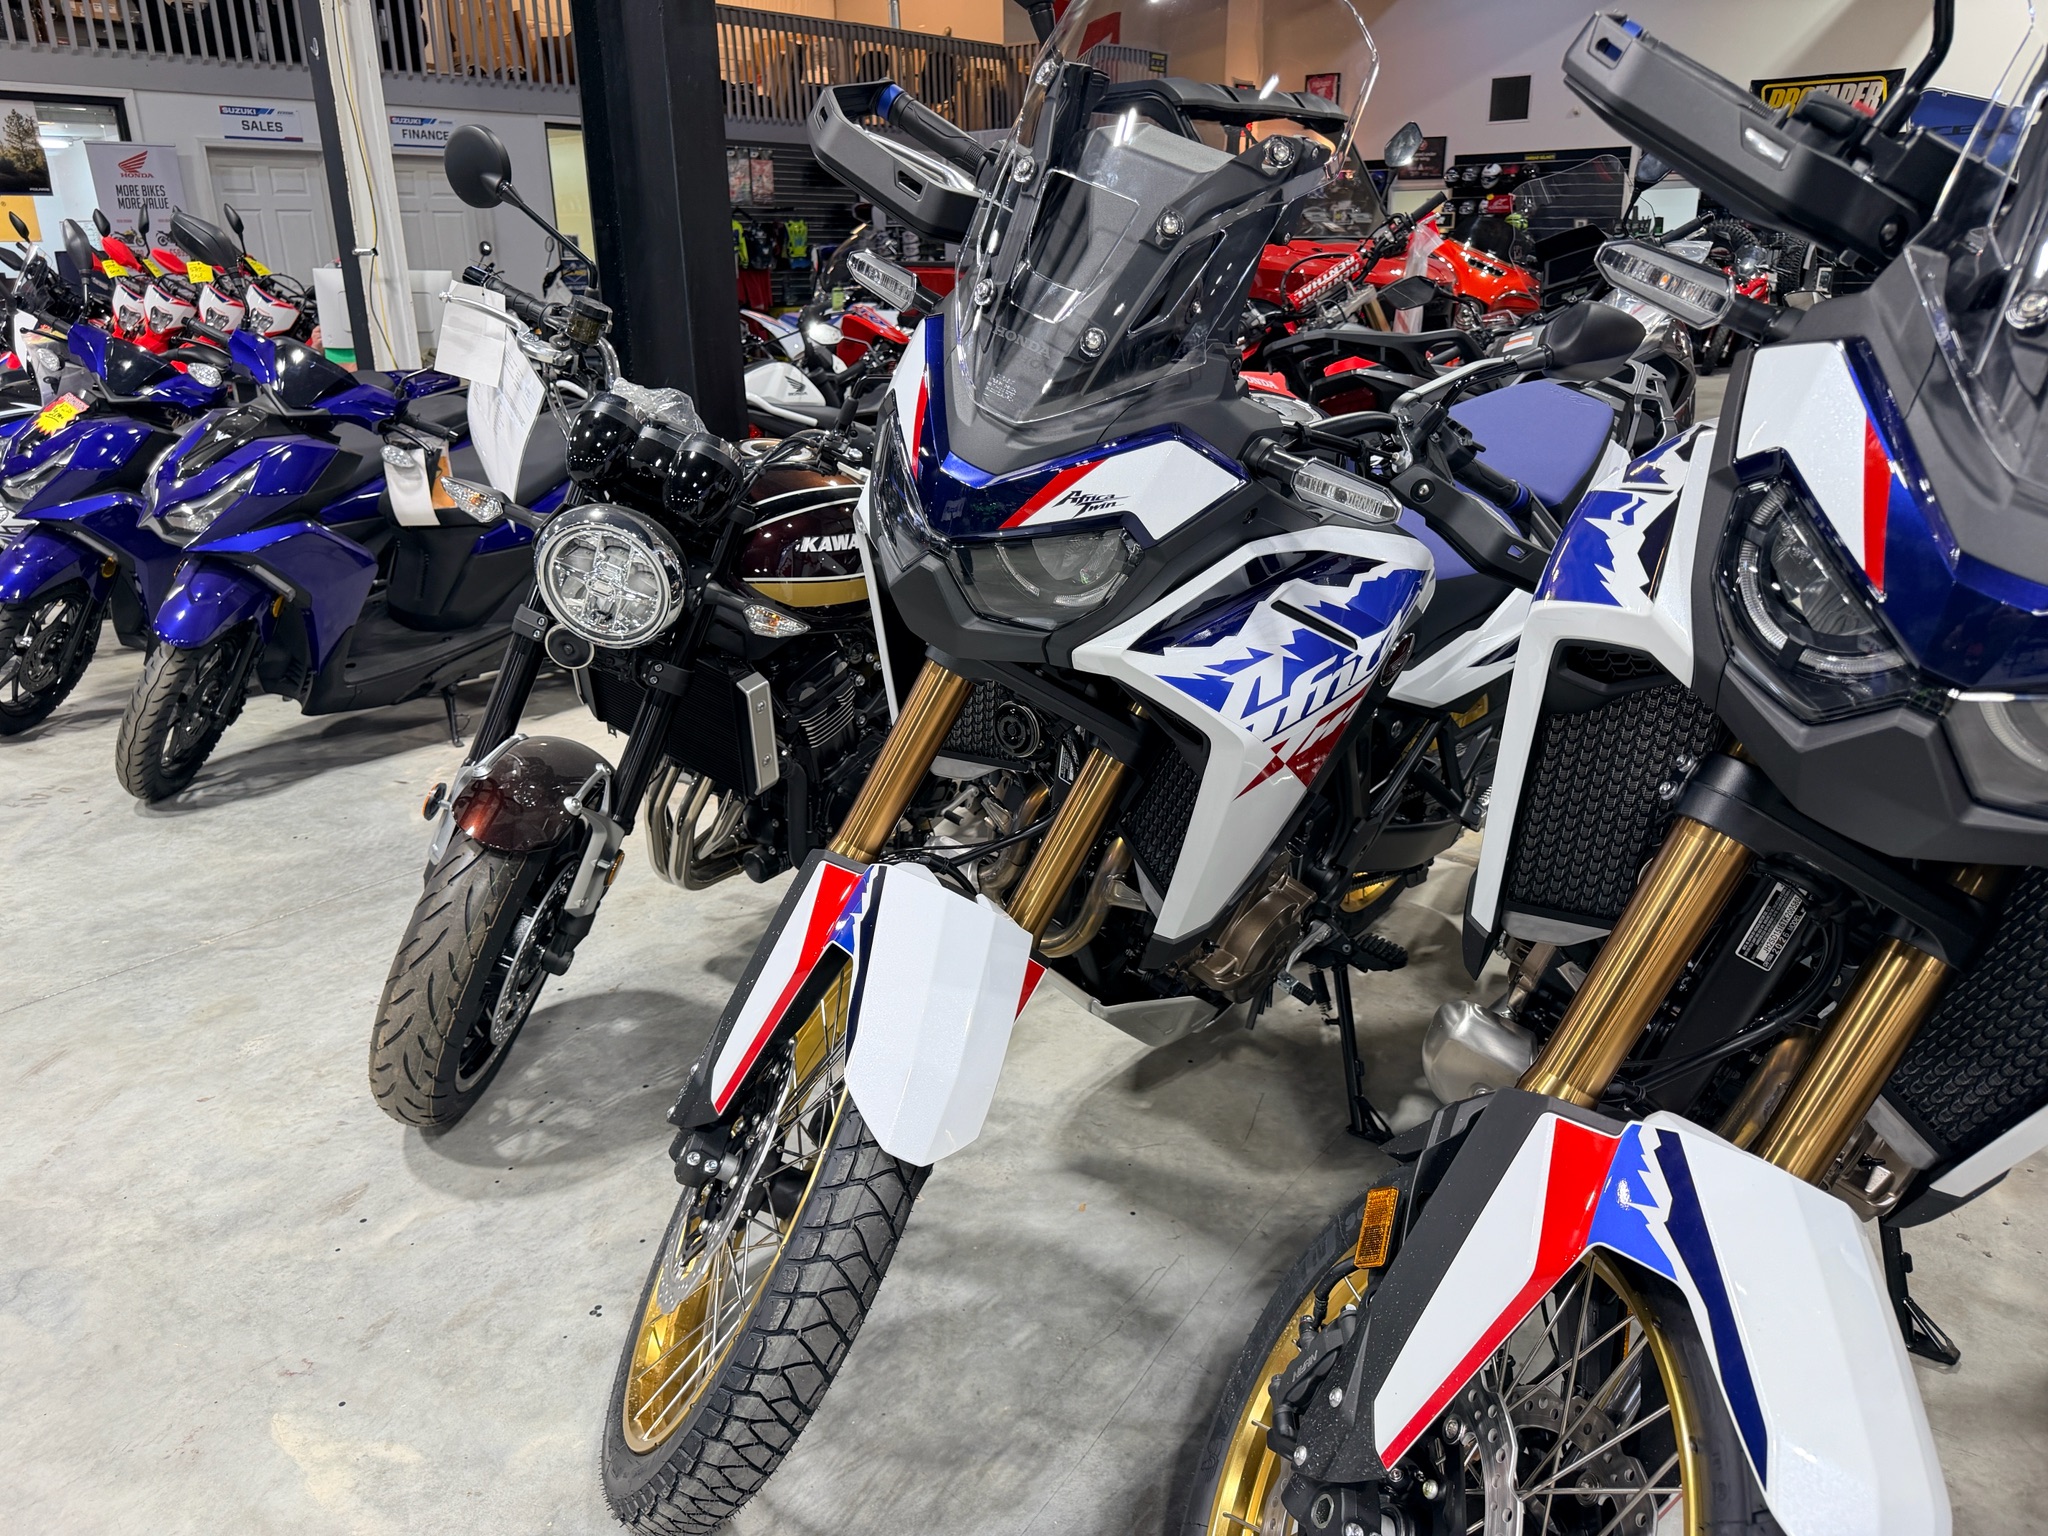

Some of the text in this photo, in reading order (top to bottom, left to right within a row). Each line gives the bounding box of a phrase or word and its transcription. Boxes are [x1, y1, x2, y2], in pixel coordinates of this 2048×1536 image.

[221, 107, 257, 115] SUZUKI
[241, 120, 283, 132] SALES
[391, 117, 422, 125] SUZUKI
[402, 129, 450, 141] FINANCE
[115, 184, 166, 197] MORE BIKES
[117, 197, 169, 210] MORE VALUE
[1294, 256, 1356, 299] RENTHAL
[1298, 263, 1360, 306] RENTHAL
[993, 325, 1051, 360] HONDA
[1052, 490, 1131, 508] Africa
[1772, 932, 1790, 955] 2026
[1788, 914, 1803, 931] MODEL
